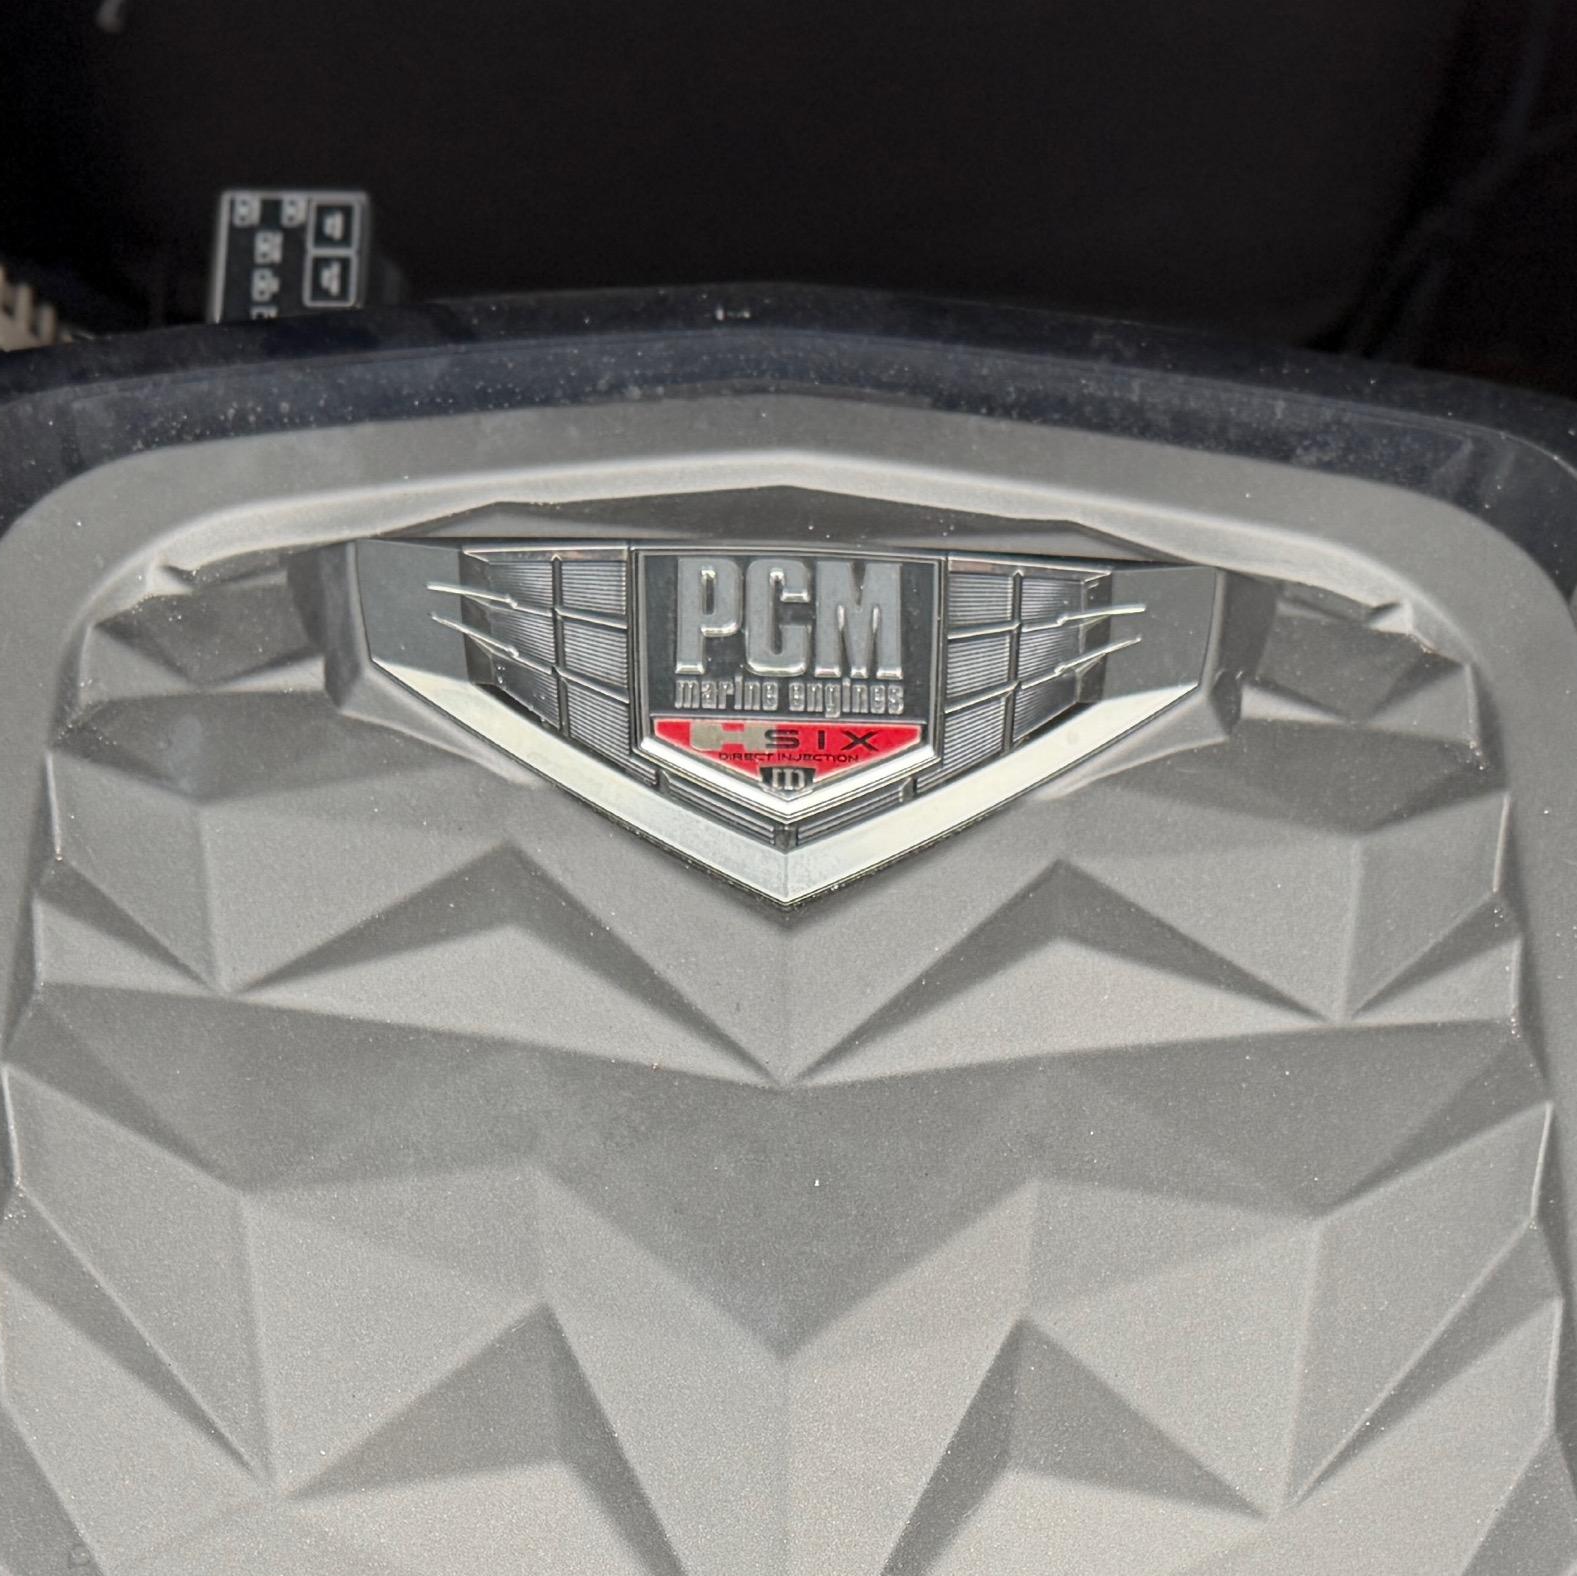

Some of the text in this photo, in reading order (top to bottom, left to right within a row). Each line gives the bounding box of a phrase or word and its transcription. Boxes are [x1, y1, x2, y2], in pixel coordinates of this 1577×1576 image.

[674, 557, 905, 680] PCM
[674, 674, 905, 719] marine engines
